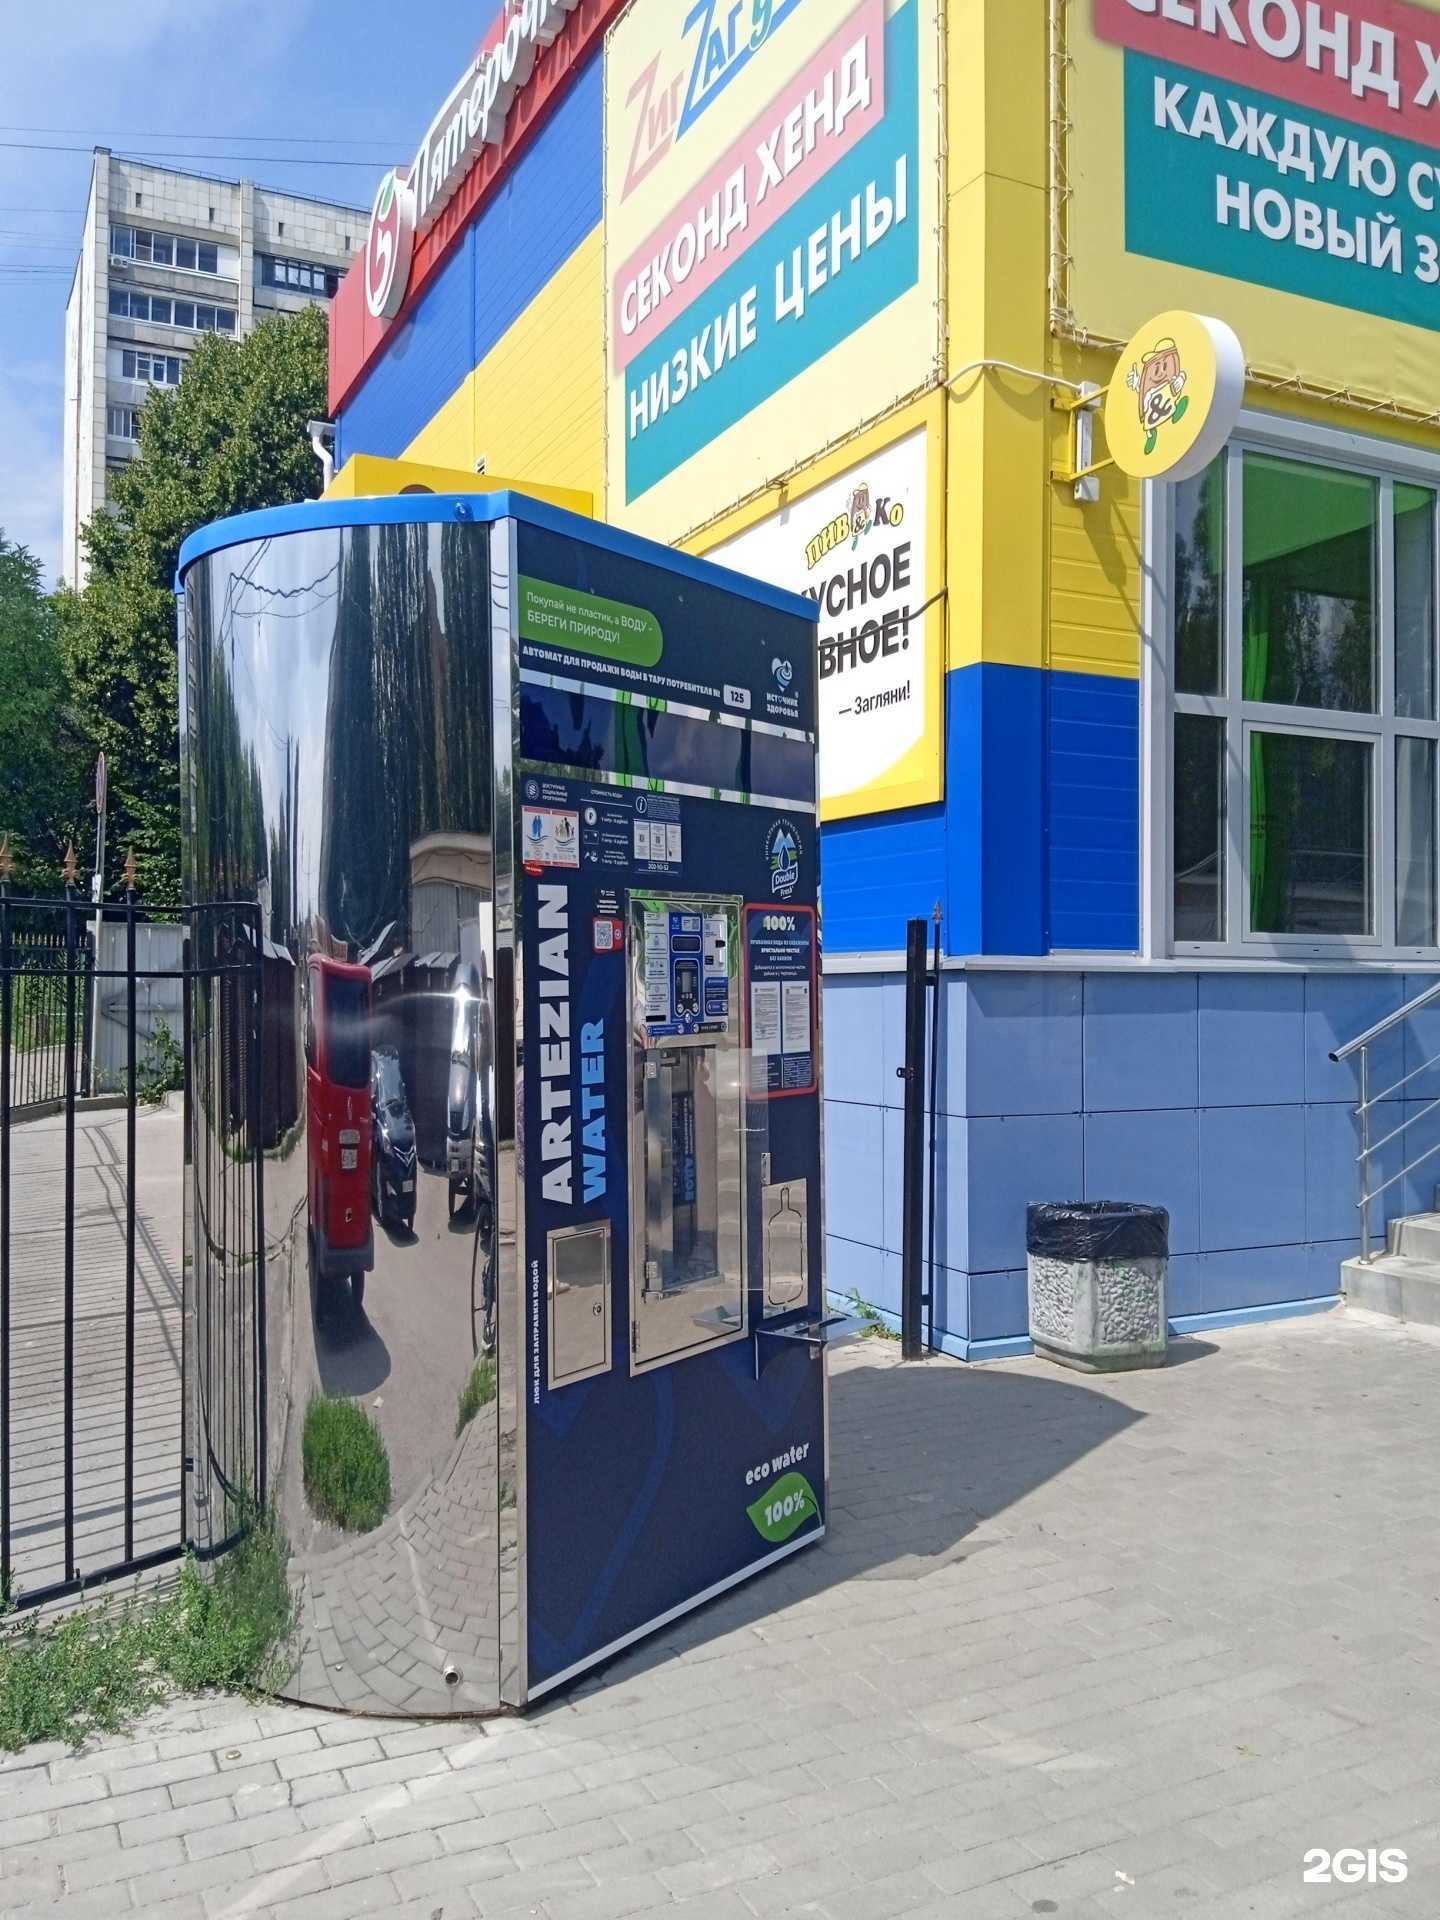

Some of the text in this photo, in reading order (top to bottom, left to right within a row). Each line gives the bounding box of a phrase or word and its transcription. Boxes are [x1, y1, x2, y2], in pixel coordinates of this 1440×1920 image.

[1125, 0, 1400, 110] КОНД
[1153, 75, 1440, 211] КАЖДУЮ С
[620, 34, 872, 336] СЕКОНД ХЕНД
[1216, 174, 1403, 275] НОВЫЙ
[630, 154, 908, 440] НИЗКИЕ ЦЕНЫ
[801, 541, 911, 618] УСНОЕ
[527, 591, 564, 612] Покупай
[566, 604, 577, 614] не
[578, 606, 614, 625] пластик,
[621, 615, 647, 633] ВОДУ
[527, 609, 620, 643] БЕРЕГИ ПРИРОДУ!
[523, 645, 562, 663] АВТОМАТ
[563, 655, 580, 667] ДЛЯ
[581, 659, 620, 675] ПРОДАЖИ
[621, 667, 642, 680] ВОДЫ
[643, 672, 648, 681] В
[649, 673, 666, 686] ТАРУ
[667, 678, 713, 695] ПОТРЕБИТЕЛЯ
[730, 690, 745, 704] 125
[767, 703, 799, 718] ЗДОРОВЬЯ
[854, 680, 911, 716] Загляни!
[775, 869, 796, 884] Double
[763, 915, 796, 931] 100%
[537, 884, 573, 1205] ARTEZIAN
[581, 1017, 607, 1204] WATER
[531, 1260, 539, 1298] ВОДОЙ
[533, 1355, 541, 1378] ДЛЯ
[533, 1378, 541, 1404] ЛЮК
[745, 1442, 810, 1486] eco water
[764, 1488, 806, 1527] 100%
